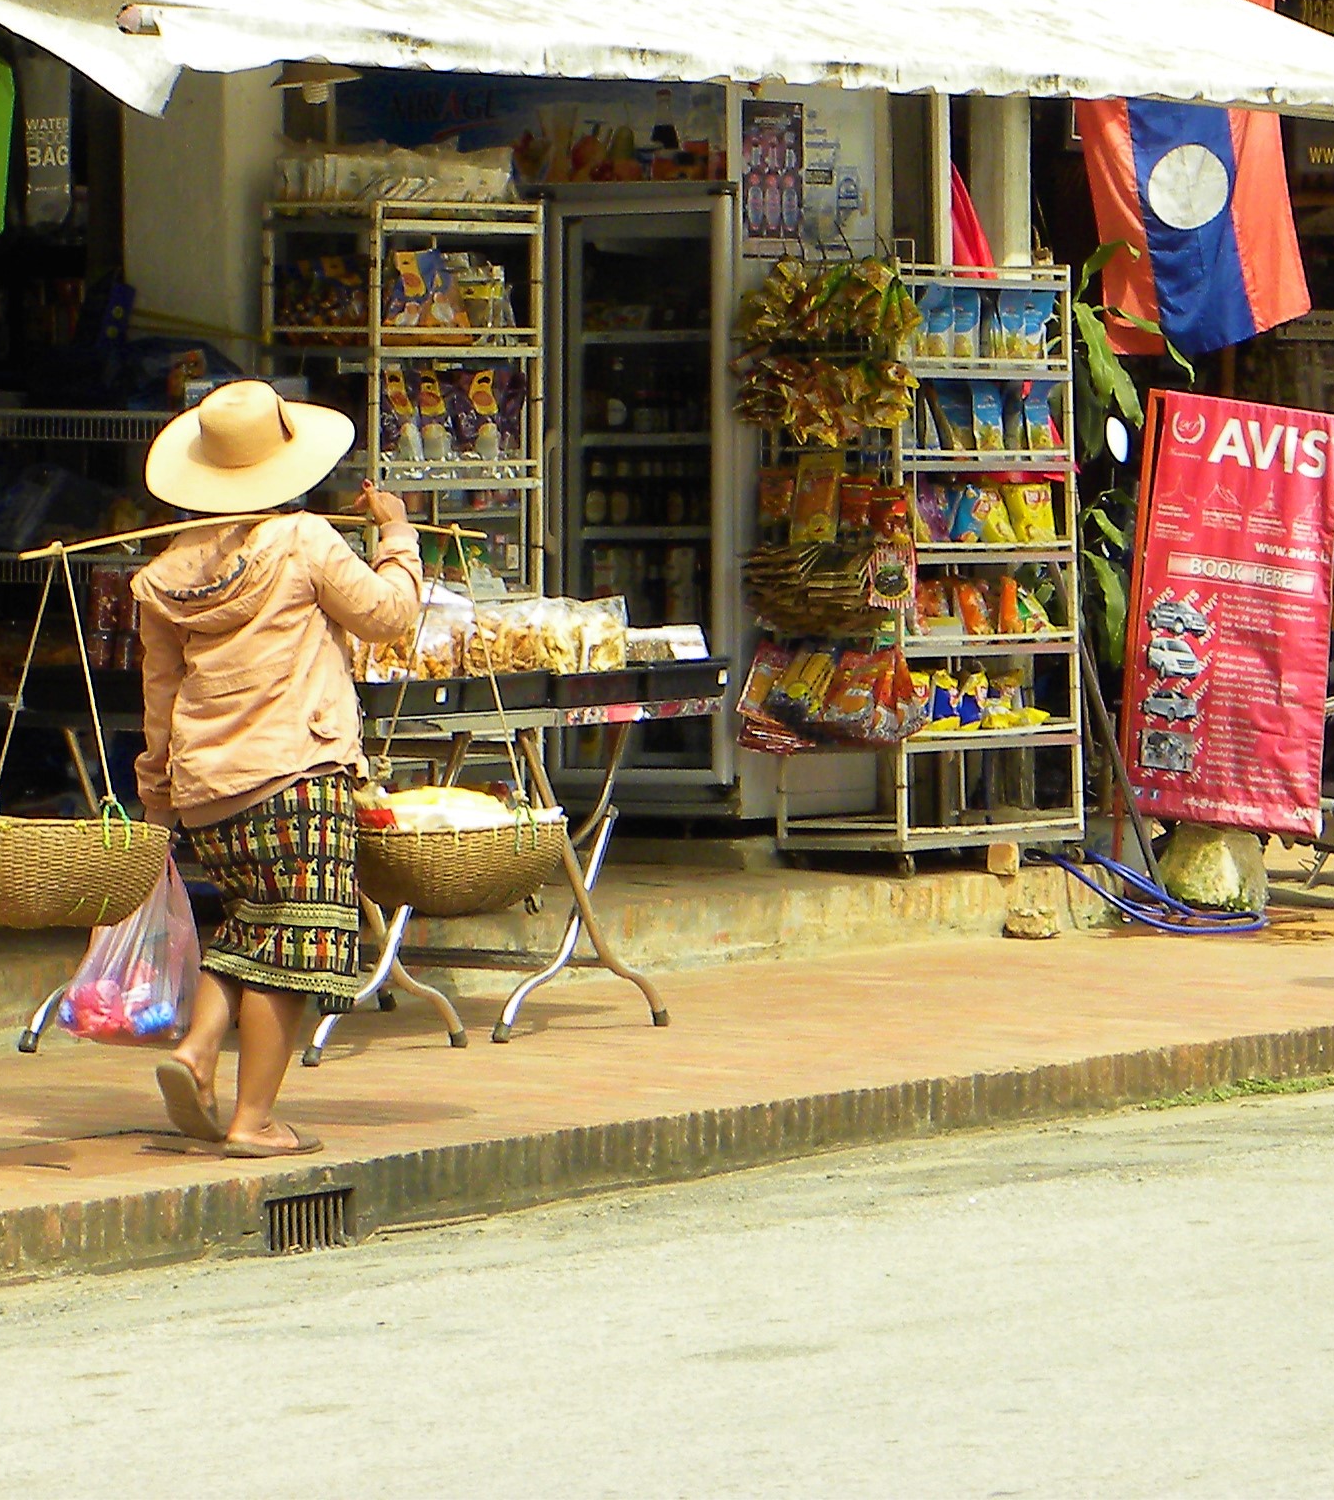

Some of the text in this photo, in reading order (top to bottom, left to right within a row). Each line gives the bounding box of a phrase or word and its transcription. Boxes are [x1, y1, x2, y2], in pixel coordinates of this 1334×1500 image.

[26, 146, 69, 167] BAG
[1208, 417, 1329, 479] AVIS
[1190, 557, 1295, 589] BOOK HERE
